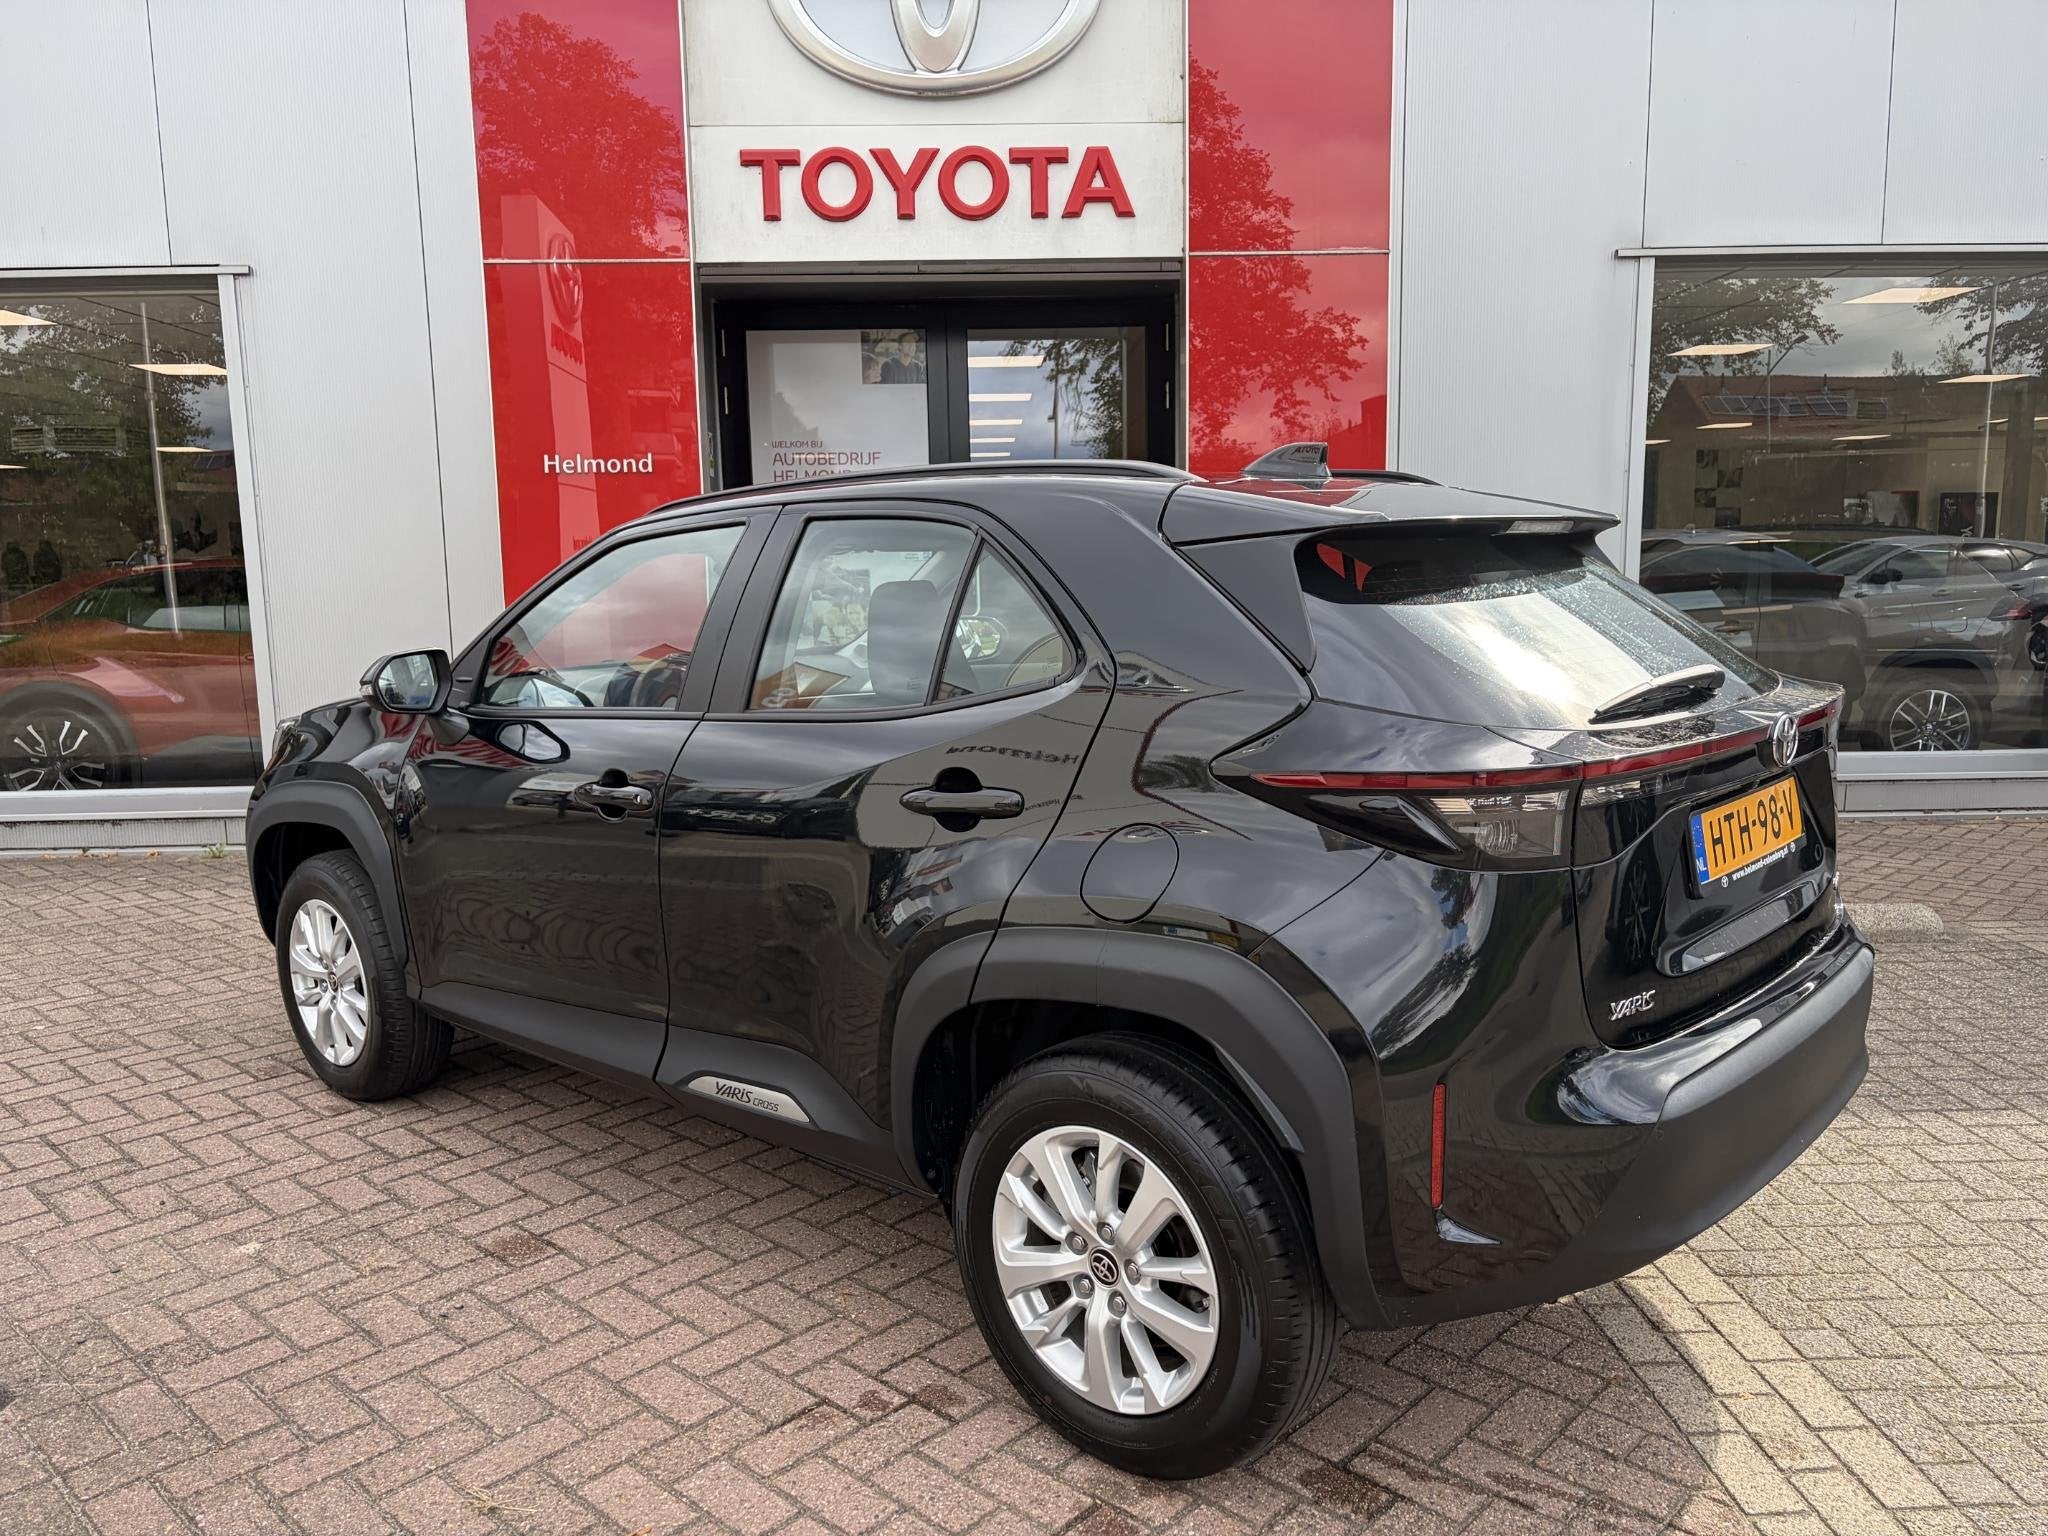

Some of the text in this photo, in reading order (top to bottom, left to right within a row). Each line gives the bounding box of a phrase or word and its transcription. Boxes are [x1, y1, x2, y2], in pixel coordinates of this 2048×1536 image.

[740, 145, 1136, 222] TOYOTA
[771, 440, 809, 449] WELKOM
[543, 453, 653, 474] Helmond
[772, 451, 882, 466] AUTOBEDRIJF
[773, 469, 852, 482] HELM
[1709, 787, 1794, 868] HTH-98-V
[1696, 857, 1707, 873] NL
[752, 1097, 779, 1112] CROSS
